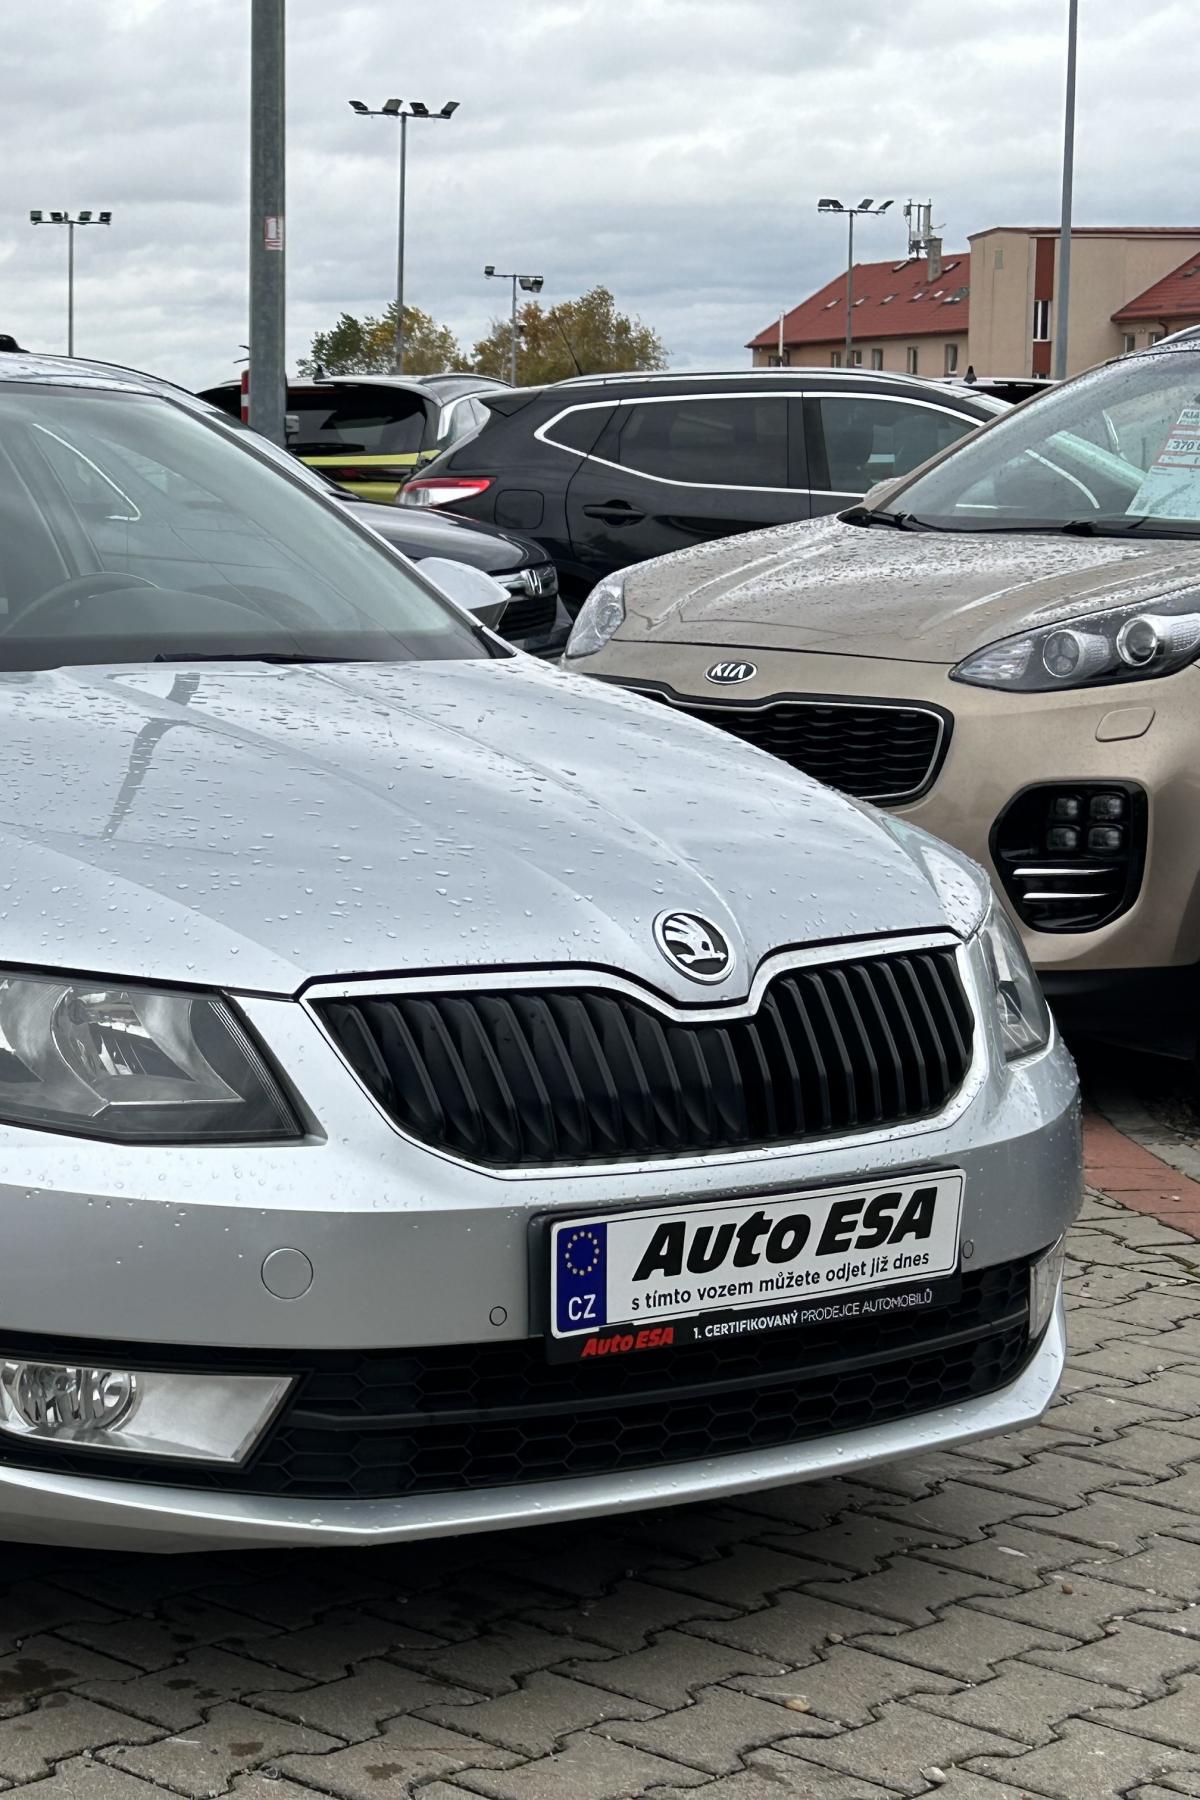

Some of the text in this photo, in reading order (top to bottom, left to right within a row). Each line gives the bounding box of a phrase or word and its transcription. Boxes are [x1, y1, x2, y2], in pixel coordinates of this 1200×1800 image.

[710, 663, 747, 679] KIA
[632, 1186, 938, 1281] Auto ESA
[631, 1252, 930, 1311] s tímto vozem můžete odjet již dnes
[568, 1294, 597, 1321] CZ
[693, 1287, 933, 1340] 1. CERTIFIKOVANÝ PRODEJCE AUTOMOBILŮ
[581, 1326, 675, 1358] Auto ESA
